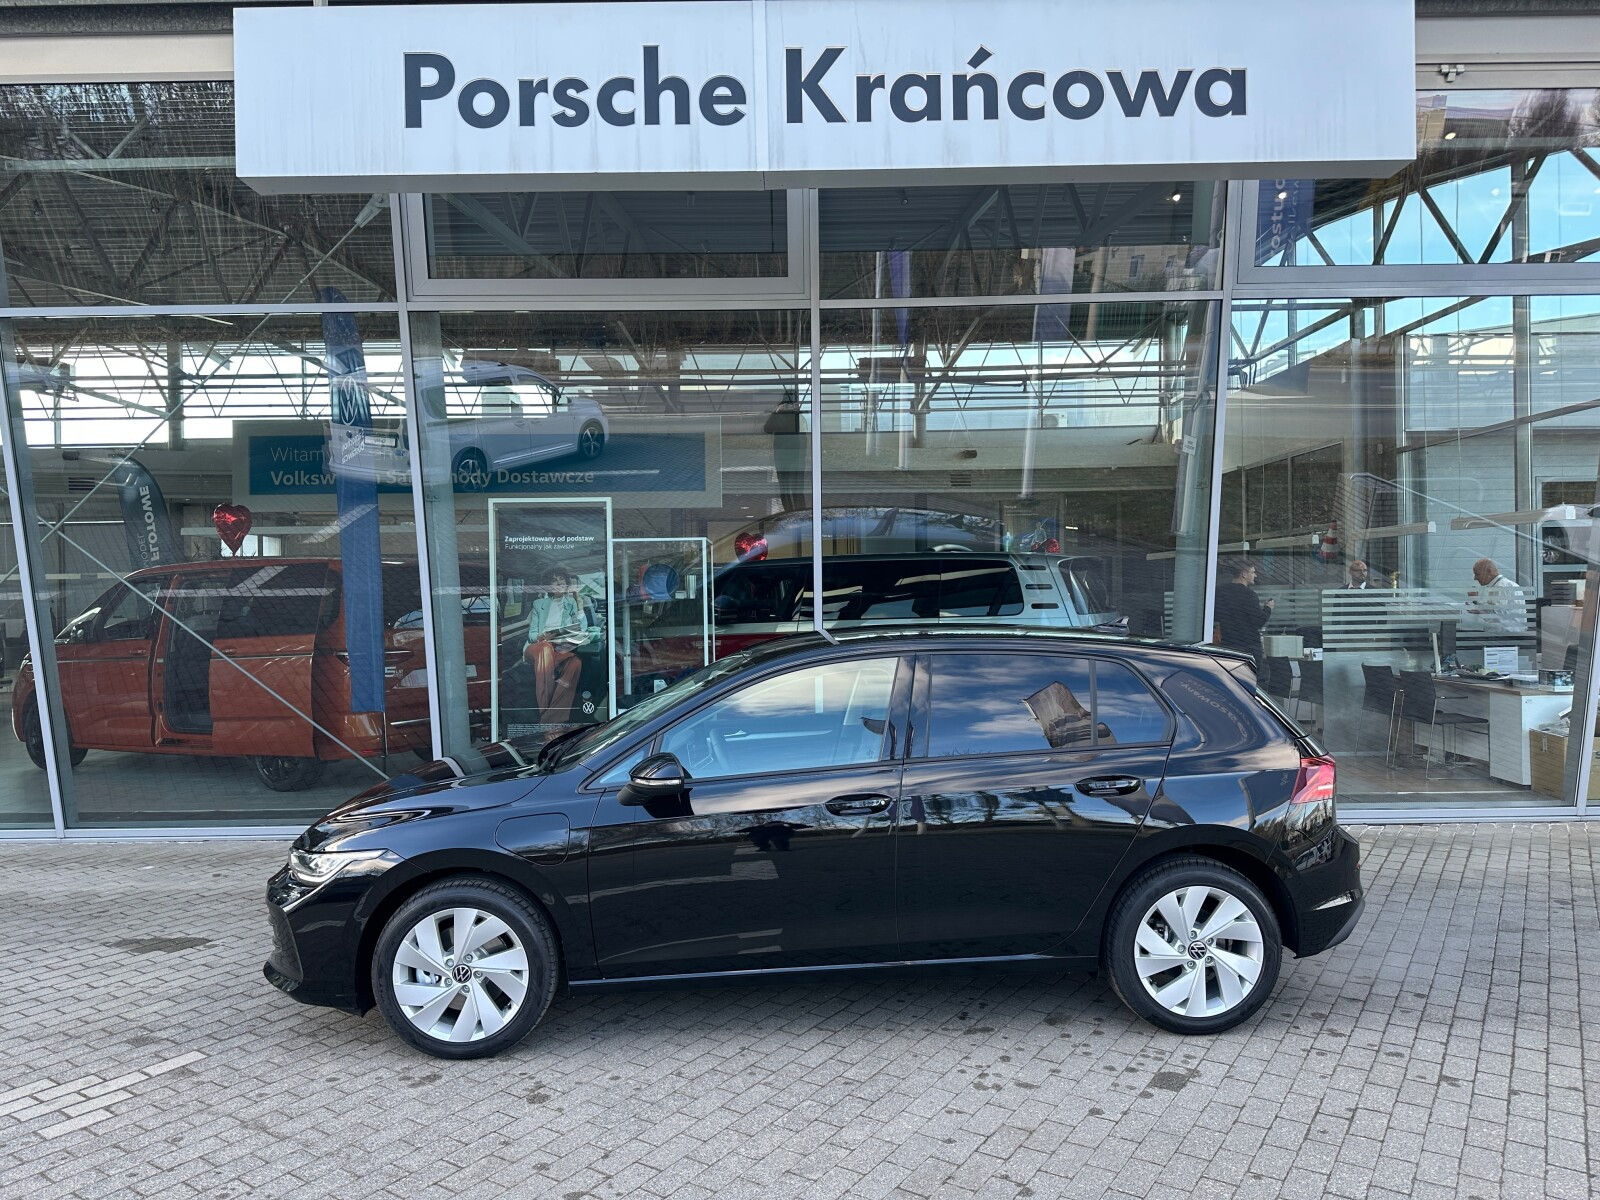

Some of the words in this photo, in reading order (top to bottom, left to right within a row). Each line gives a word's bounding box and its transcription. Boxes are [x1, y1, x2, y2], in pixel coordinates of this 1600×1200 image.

[403, 45, 747, 129] Porsche
[785, 44, 1248, 124] Krańcowa
[497, 469, 594, 485] Dostawcze
[504, 535, 555, 543] Zaprojektowany
[566, 535, 595, 543] podstaw
[543, 543, 552, 551] jak
